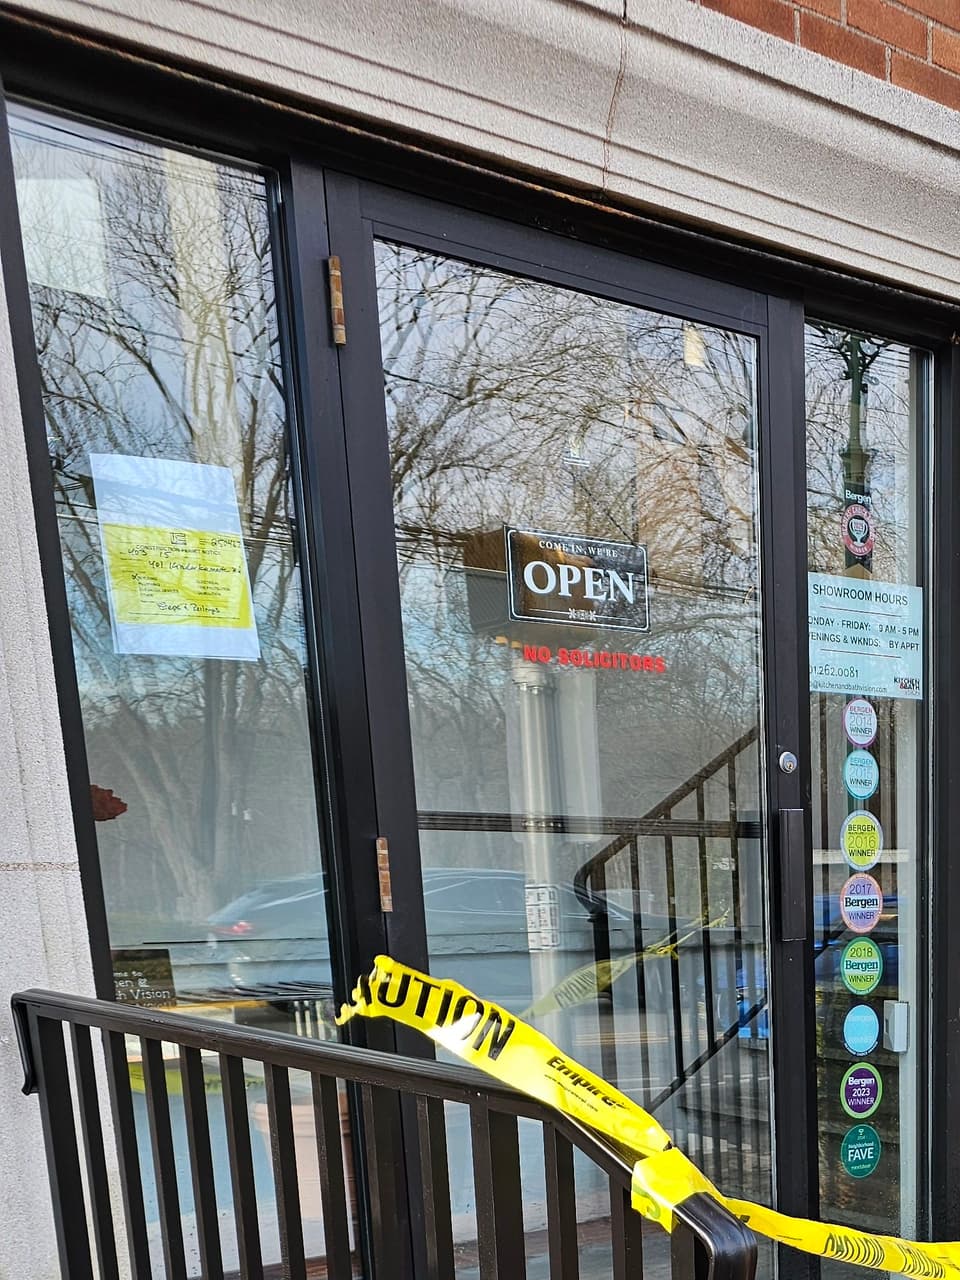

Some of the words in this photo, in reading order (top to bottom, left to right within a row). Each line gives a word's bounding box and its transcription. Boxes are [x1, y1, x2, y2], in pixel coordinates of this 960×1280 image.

[845, 489, 872, 504] Bergen
[539, 540, 568, 552] COME
[571, 544, 587, 555] IN,
[588, 546, 618, 558] WE'RE
[523, 560, 635, 605] OPEN
[812, 583, 873, 602] SHOWROOM
[875, 592, 909, 606] HOURS
[808, 615, 836, 627] ONDAY
[841, 619, 871, 632] FRIDAY:
[885, 625, 897, 634] AM
[902, 626, 907, 635] 5
[908, 627, 920, 637] PM
[809, 631, 841, 643] ENINGS
[843, 634, 849, 644] &
[850, 635, 881, 648] WKNDS:
[889, 640, 900, 650] BY
[900, 641, 920, 652] APPT
[523, 644, 551, 664] NO
[558, 648, 666, 673] SOLICITORS
[809, 663, 859, 678] 1.262.0081
[849, 715, 872, 726] 2014
[849, 726, 873, 735] WINNER
[849, 778, 872, 787] WINNER
[847, 824, 876, 832] BERGEN
[847, 835, 876, 848] 2016
[848, 848, 876, 857] WINNER
[849, 883, 872, 895] 2017
[844, 896, 878, 908] Bergen
[848, 911, 875, 920] WINNER
[849, 946, 873, 958] 2018
[845, 960, 878, 972] Bergen
[848, 974, 875, 983] WINNER
[129, 988, 171, 1000] Vision
[546, 1055, 616, 1107] Empire
[847, 1077, 875, 1087] Bergen
[852, 1087, 871, 1097] 2023
[847, 1097, 875, 1106] WINNER
[848, 1147, 874, 1162] FAVE
